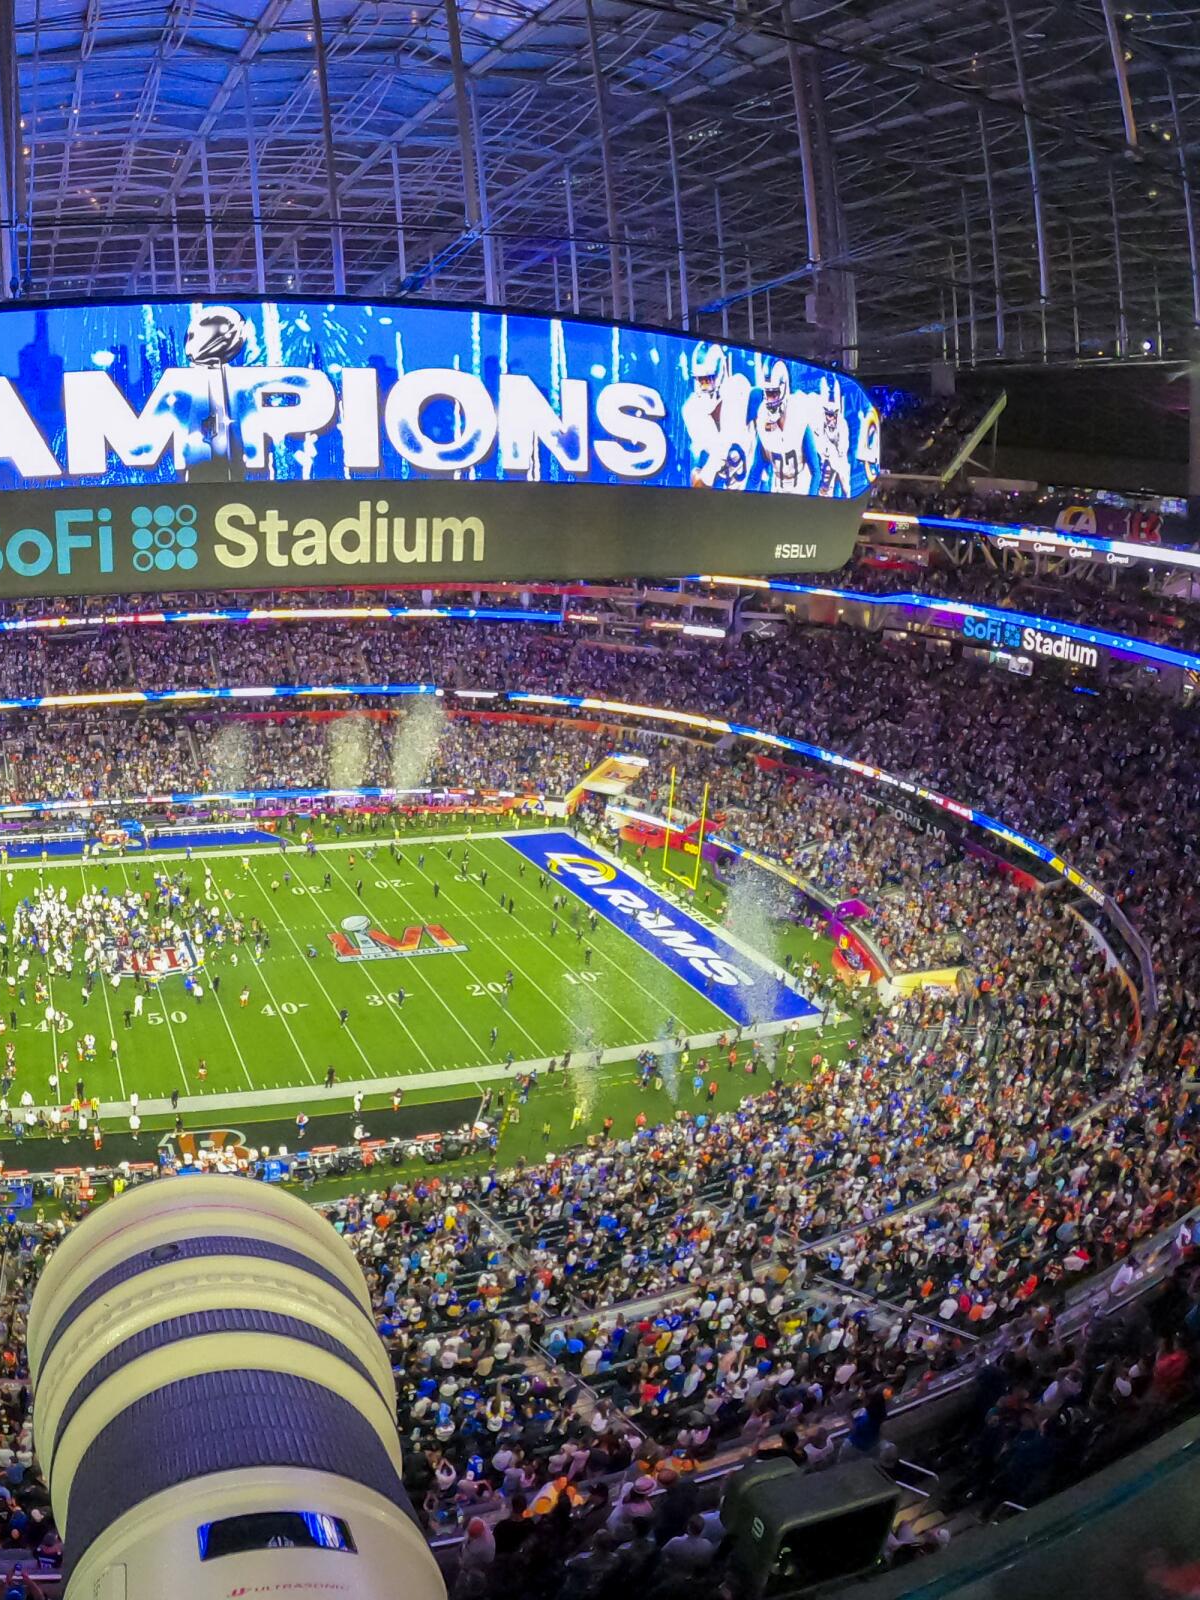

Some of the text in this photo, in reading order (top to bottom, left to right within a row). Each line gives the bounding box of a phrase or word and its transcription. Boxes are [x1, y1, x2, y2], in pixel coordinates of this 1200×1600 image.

[771, 449, 798, 488] 77
[213, 500, 485, 570] Stadium
[774, 542, 818, 561] #SBLVI
[963, 616, 1001, 642] SoFi
[1022, 628, 1098, 668] Stadium
[291, 885, 324, 896] 30
[374, 879, 406, 889] 20
[593, 886, 755, 986] RAMS
[147, 1010, 188, 1026] 50
[260, 1001, 299, 1017] 40
